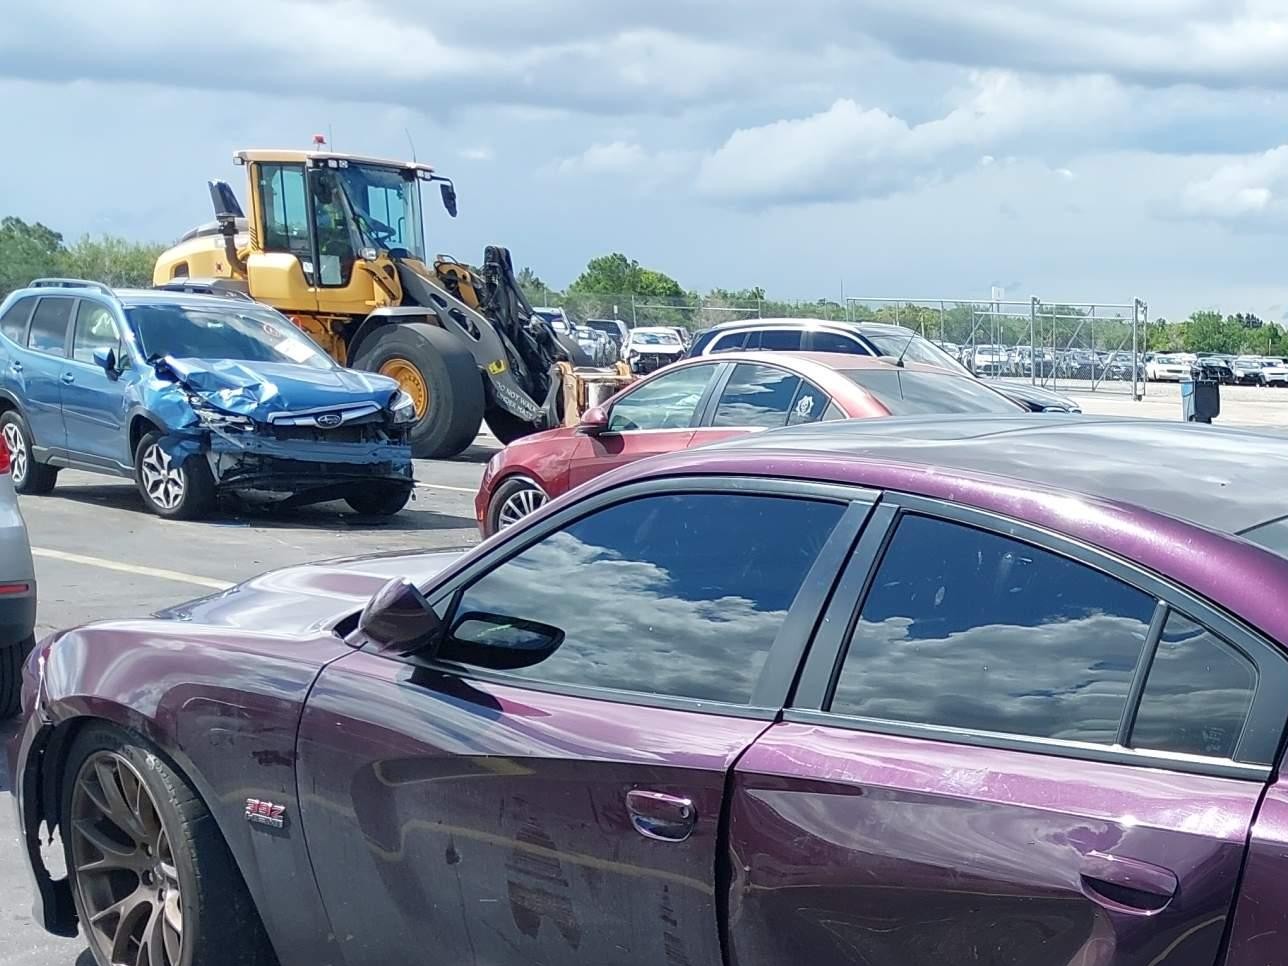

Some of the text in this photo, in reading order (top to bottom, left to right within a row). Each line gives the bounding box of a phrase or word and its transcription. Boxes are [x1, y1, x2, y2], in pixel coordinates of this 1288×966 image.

[506, 388, 520, 401] NOT
[520, 397, 537, 413] WALK
[245, 798, 286, 818] 392
